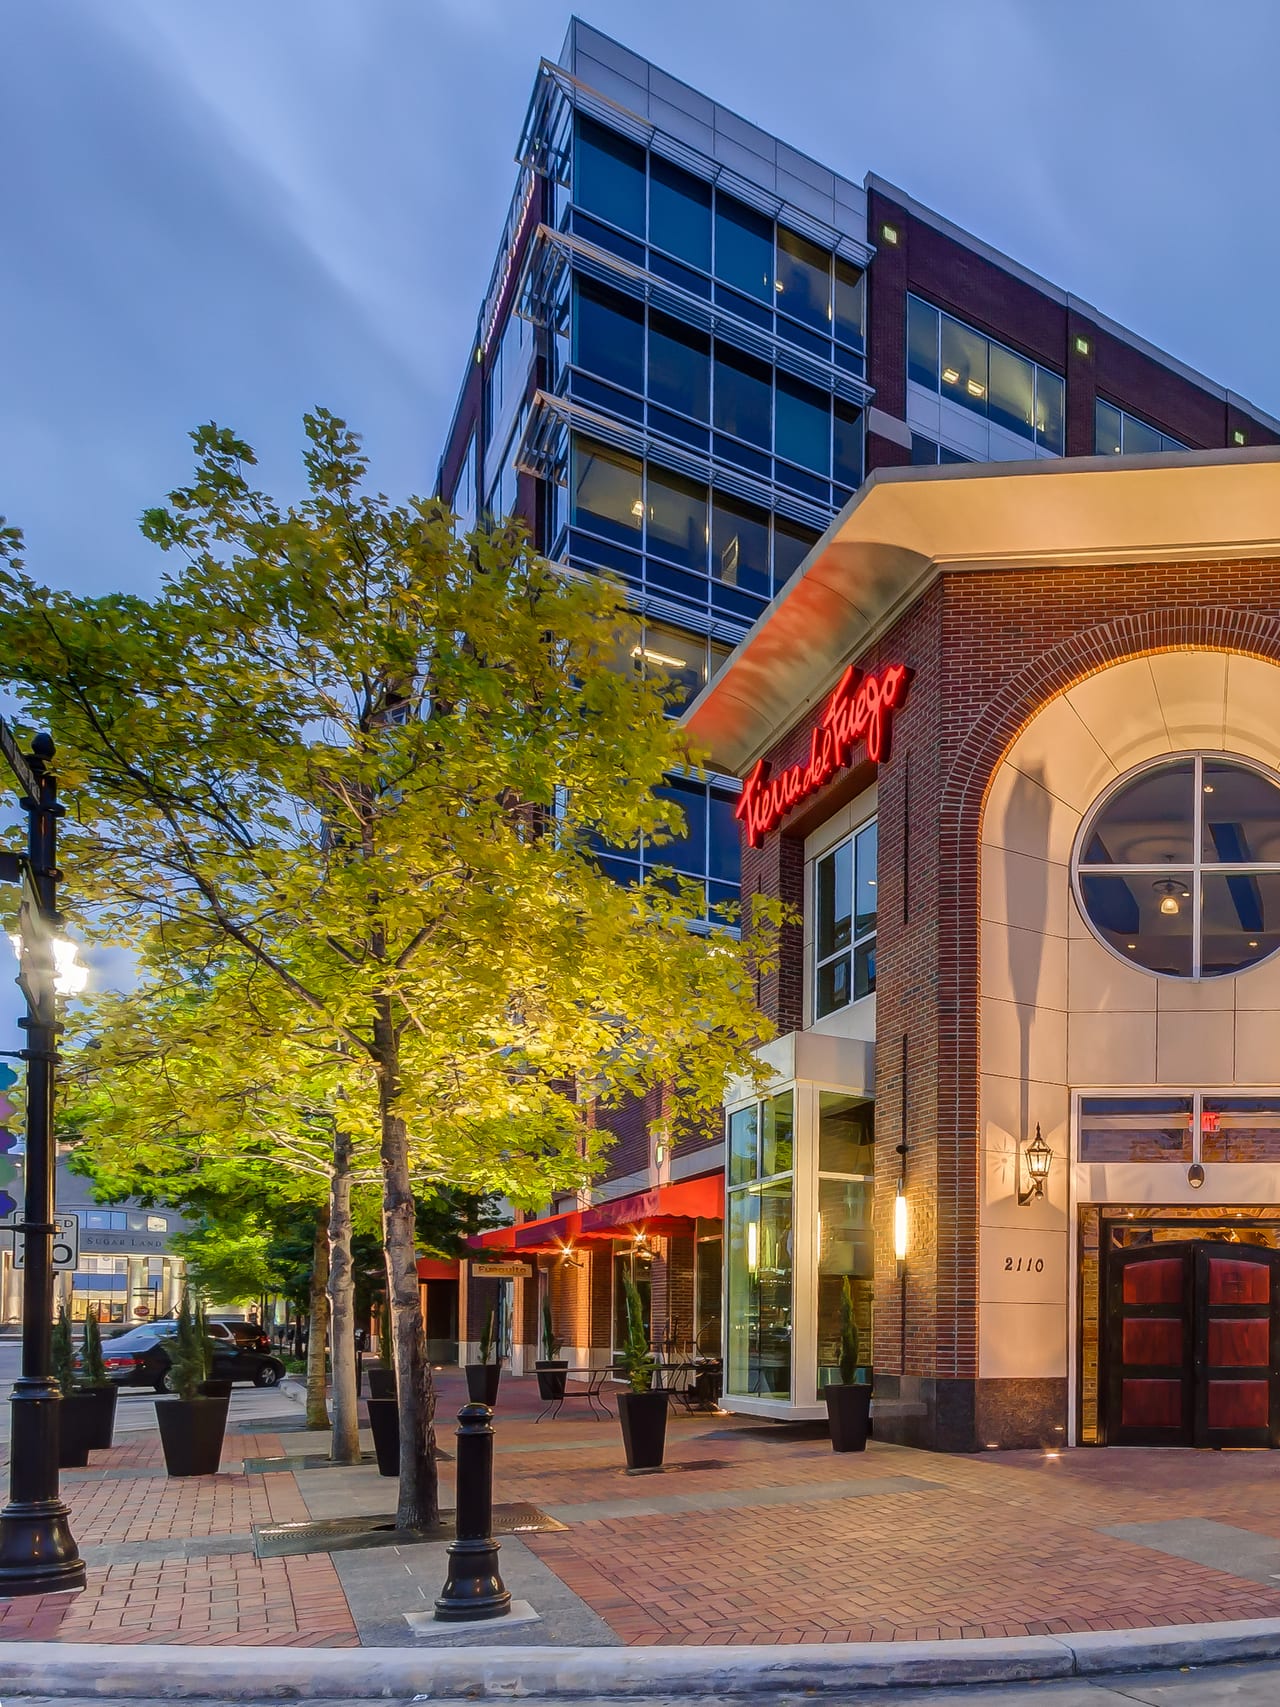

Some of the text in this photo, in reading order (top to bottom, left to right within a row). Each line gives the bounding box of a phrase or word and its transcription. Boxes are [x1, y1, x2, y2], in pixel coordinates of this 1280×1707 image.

[735, 664, 907, 849] Tierra del Fuego
[131, 1239, 162, 1248] LAND
[1004, 1256, 1044, 1273] 2110
